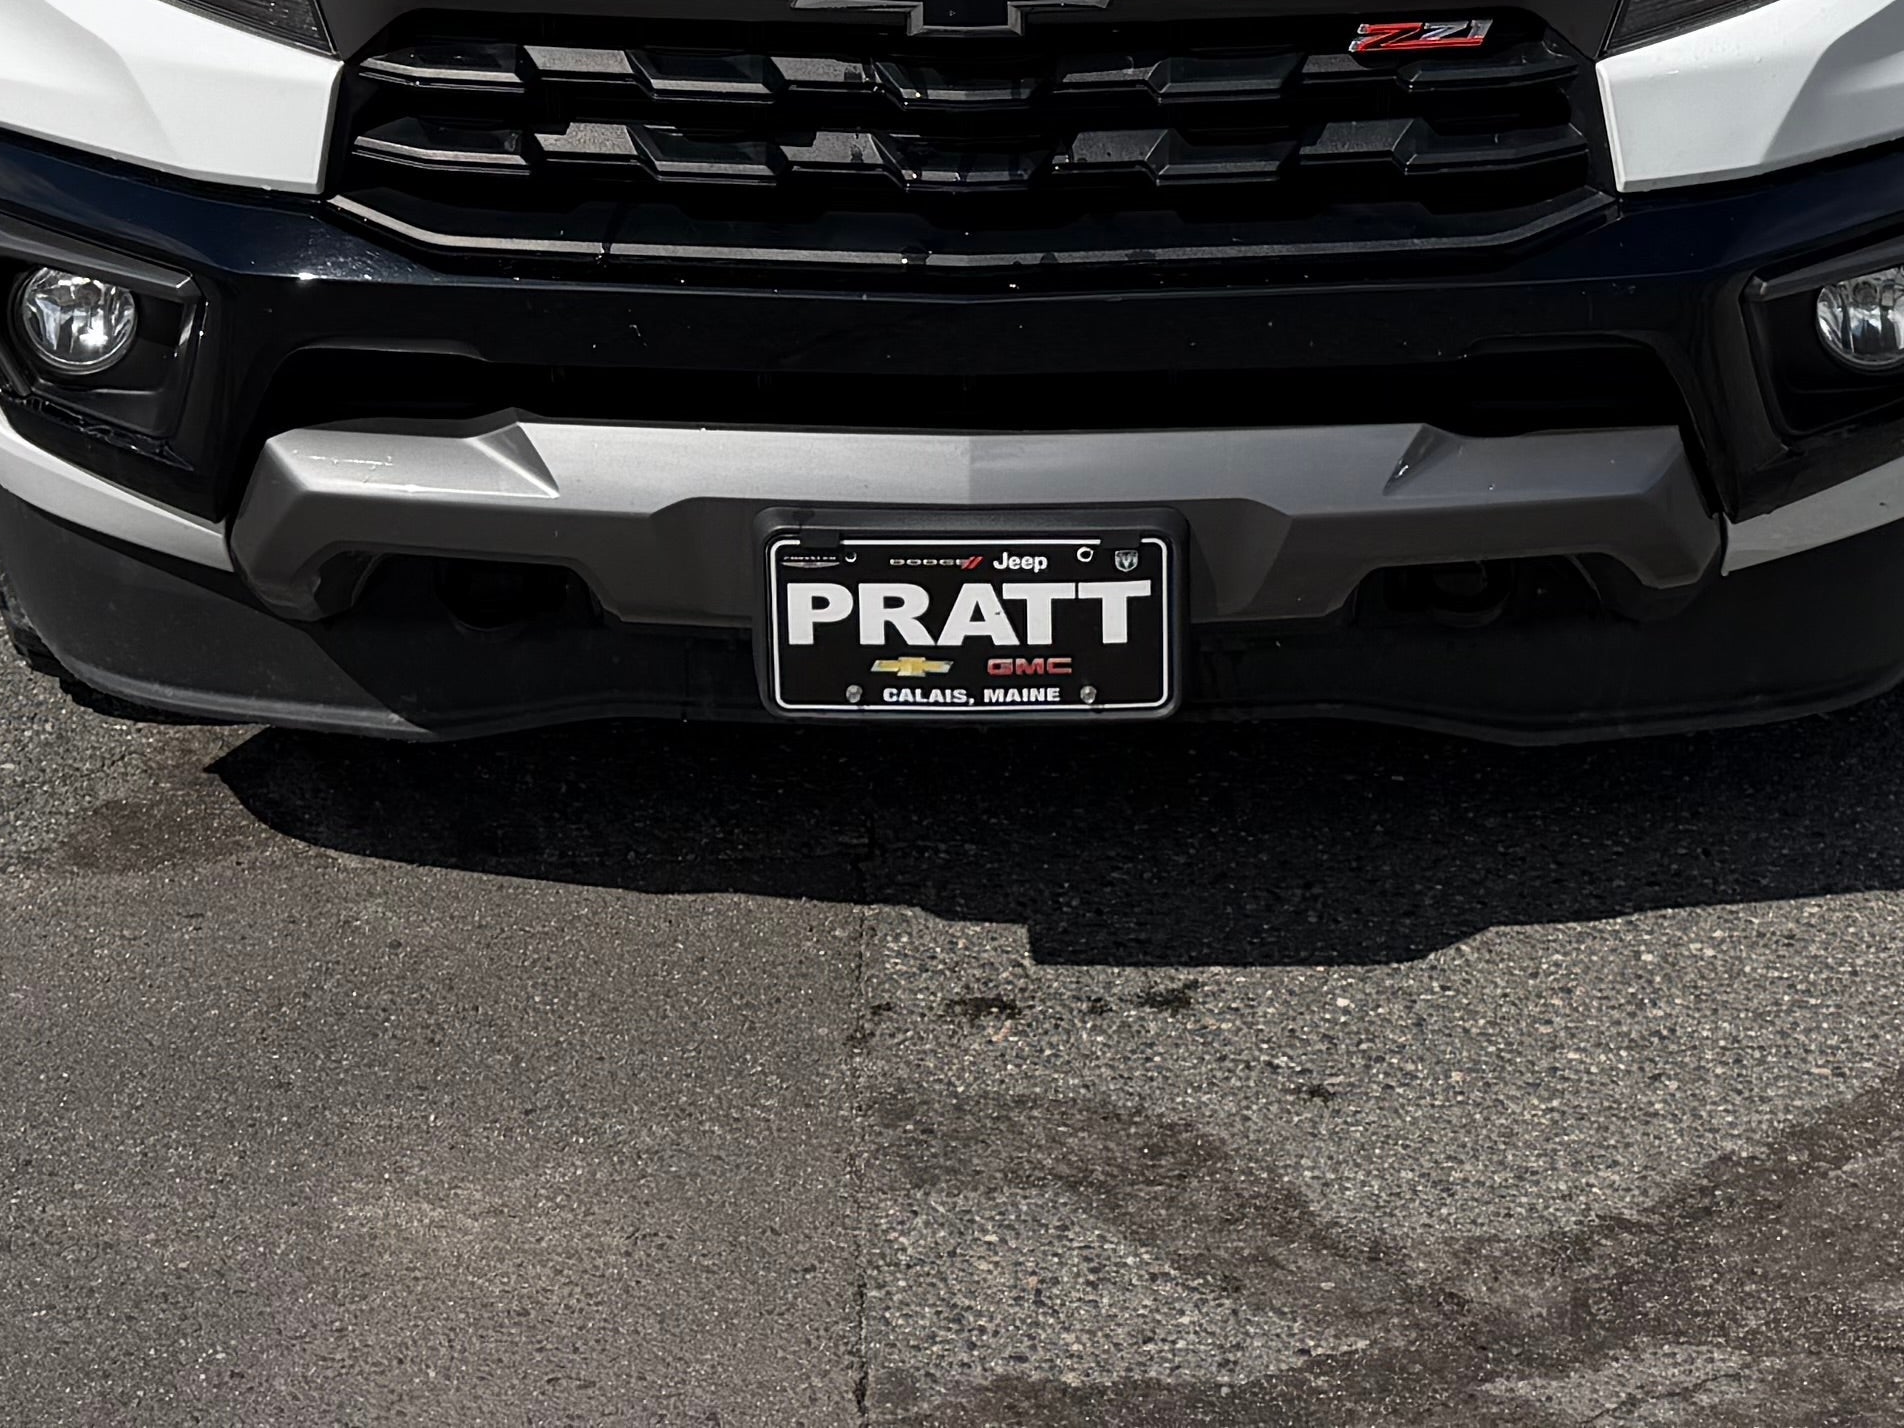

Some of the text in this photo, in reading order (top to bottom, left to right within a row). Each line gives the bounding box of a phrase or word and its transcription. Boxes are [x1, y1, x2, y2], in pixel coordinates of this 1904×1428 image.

[1348, 18, 1494, 53] Z71
[992, 551, 1048, 573] Jeep
[786, 579, 1152, 647] PRATT
[987, 657, 1073, 676] GMC
[882, 687, 1061, 706] CALAIS, MAINE
